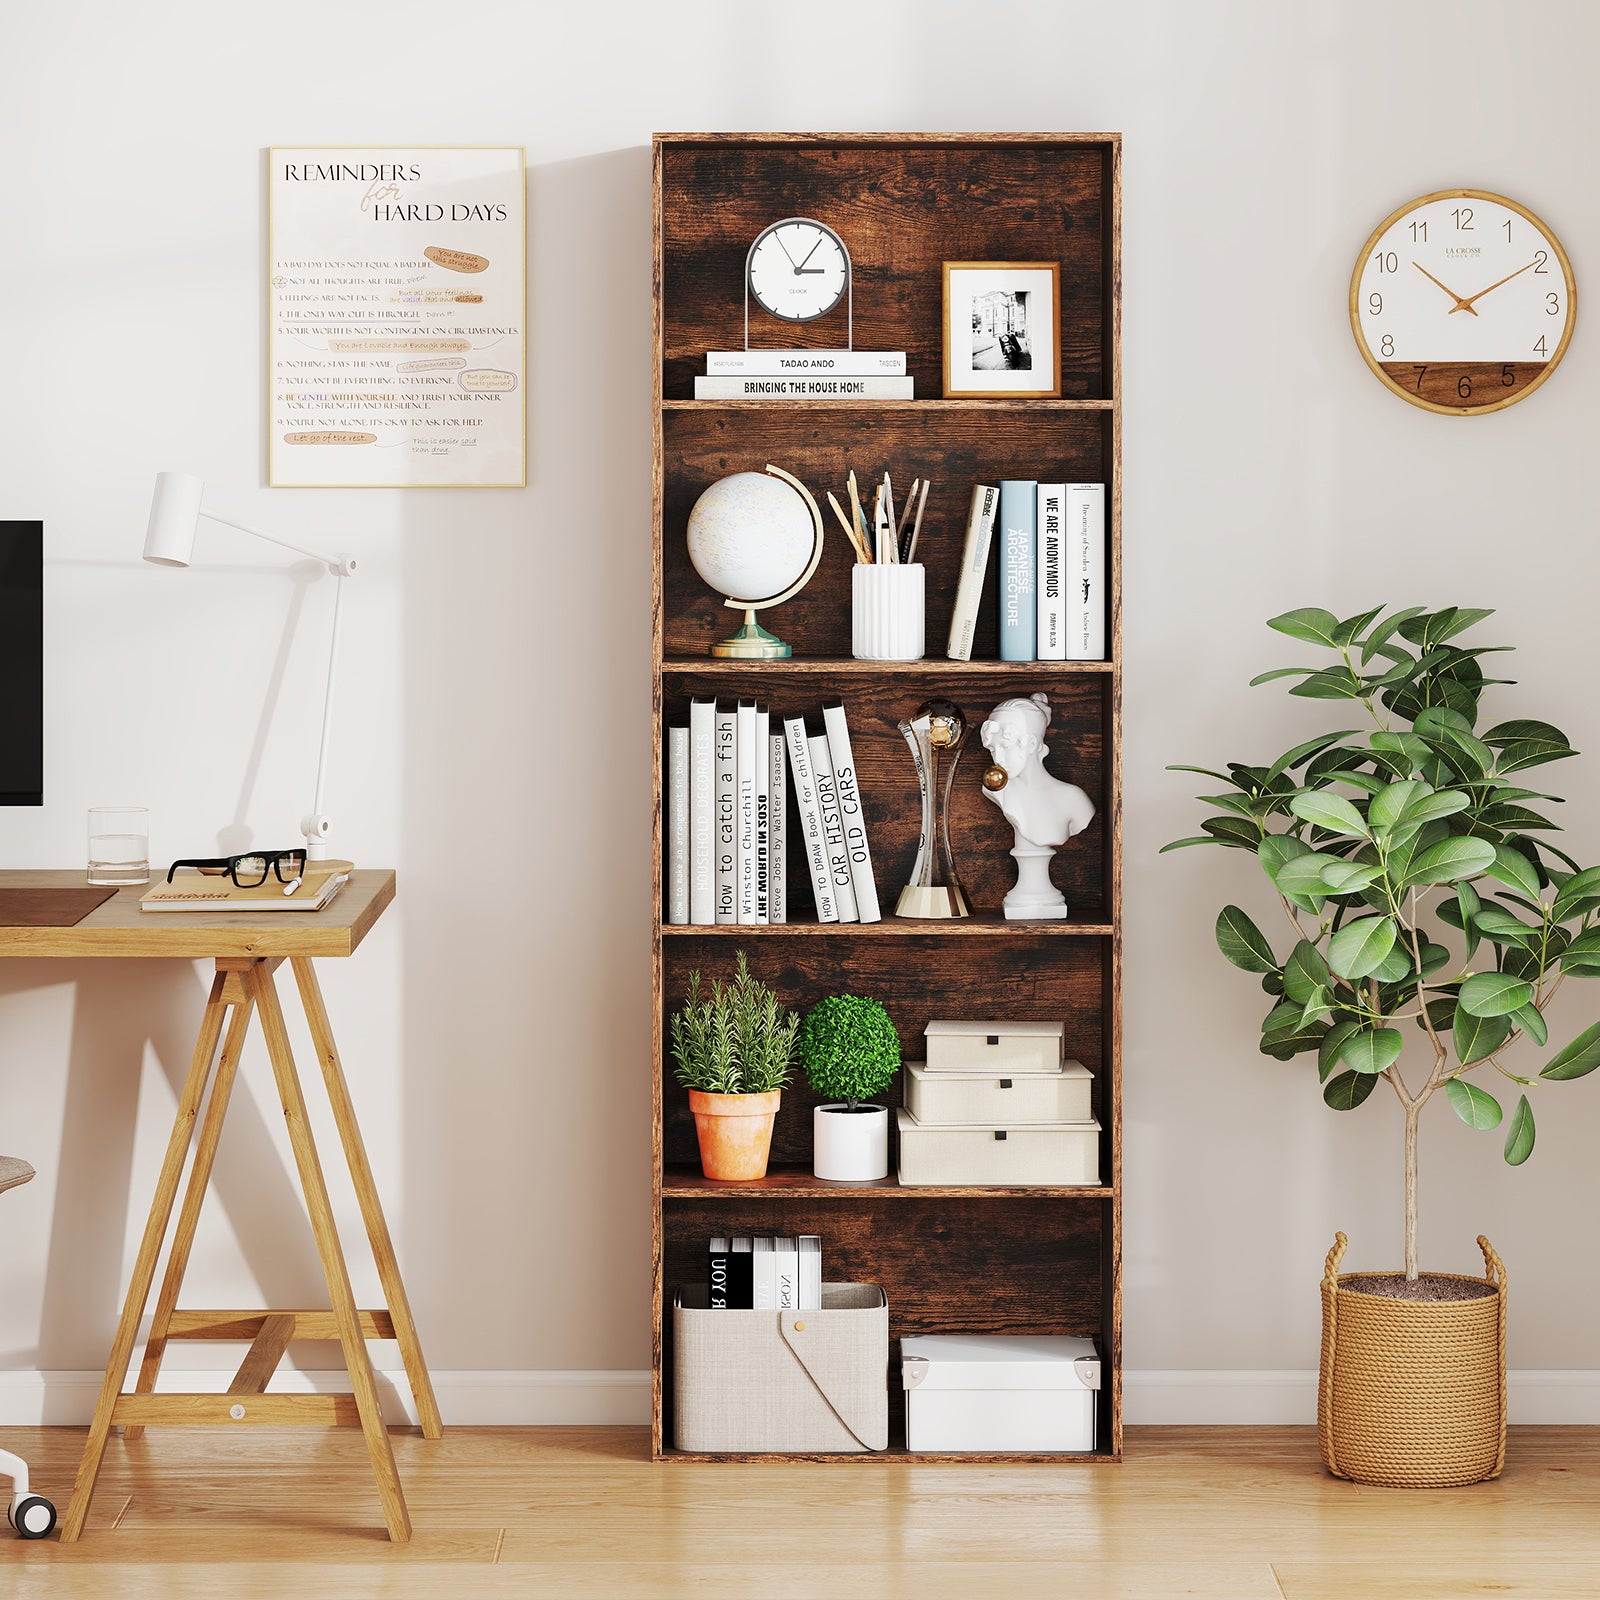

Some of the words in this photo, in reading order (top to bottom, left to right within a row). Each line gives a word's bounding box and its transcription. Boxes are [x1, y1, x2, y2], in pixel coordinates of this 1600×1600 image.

[285, 164, 421, 181] REMINDERS
[360, 178, 402, 212] for
[375, 204, 444, 222] HARD
[452, 204, 507, 222] DAYS
[1451, 208, 1474, 230] 12
[1408, 221, 1427, 243] 11
[1502, 219, 1511, 243] 1
[365, 261, 391, 270] EQUAL
[1375, 252, 1399, 274] 10
[1534, 250, 1548, 274] 2
[1369, 292, 1383, 315] 9
[1545, 292, 1559, 315] 3
[286, 327, 310, 335] YOUR
[312, 327, 344, 335] WORTH
[345, 327, 352, 335] IS
[354, 327, 372, 335] NOT
[374, 327, 430, 335] CONTINGENT
[432, 327, 446, 335] ON
[1380, 334, 1395, 357] 8
[1532, 334, 1548, 357] 4
[780, 360, 809, 368] TADAO
[810, 360, 835, 368] ANDO
[286, 377, 303, 385] YOU
[332, 377, 342, 385] BE
[344, 377, 395, 385] EVERYTHING
[398, 377, 409, 385] TO
[744, 382, 787, 393] BRINGING
[789, 382, 806, 393] THE
[808, 382, 838, 393] HOUSE
[840, 382, 865, 393] HOME
[1413, 366, 1428, 390] 7
[1457, 376, 1472, 399] 6
[1501, 365, 1515, 387] 5
[310, 435, 321, 444] go
[323, 433, 332, 444] of
[982, 488, 995, 517] FRANK
[1046, 497, 1059, 513] WE
[1046, 515, 1059, 534] ARE
[1080, 503, 1090, 536] Dreaming
[1082, 537, 1090, 546] of
[1017, 529, 1028, 594] JAPANESE
[1046, 536, 1059, 598] ANONYMOUS
[1082, 545, 1090, 572] Sweden
[1007, 529, 1018, 627] ARCHITECTURE
[676, 732, 684, 756] house
[717, 722, 733, 762] fish
[791, 724, 808, 778] children
[676, 760, 684, 774] the
[696, 733, 709, 808] DECORATES
[773, 738, 782, 787] Isaacson
[676, 779, 684, 789] in
[721, 773, 733, 783] a
[803, 785, 812, 803] for
[838, 767, 859, 815] CARS
[676, 793, 685, 846] arrangement
[717, 794, 733, 844] catch
[742, 778, 752, 850] Churchill
[773, 794, 782, 832] Walter
[817, 773, 843, 845] HISTORY
[807, 810, 819, 838] Book
[676, 850, 684, 860] an
[696, 815, 709, 891] HOUSEHOLD
[773, 837, 784, 850] by
[848, 827, 867, 863] OLD
[719, 855, 733, 874] to
[773, 856, 782, 881] Jobs
[812, 843, 824, 871] DRAW
[676, 864, 684, 884] make
[831, 854, 850, 886] CAR
[676, 887, 684, 897] to
[742, 858, 752, 914] Winston
[818, 877, 828, 891] TO
[676, 902, 684, 917] How
[718, 885, 733, 915] How
[773, 888, 782, 919] Steve
[822, 896, 833, 918] HOW
